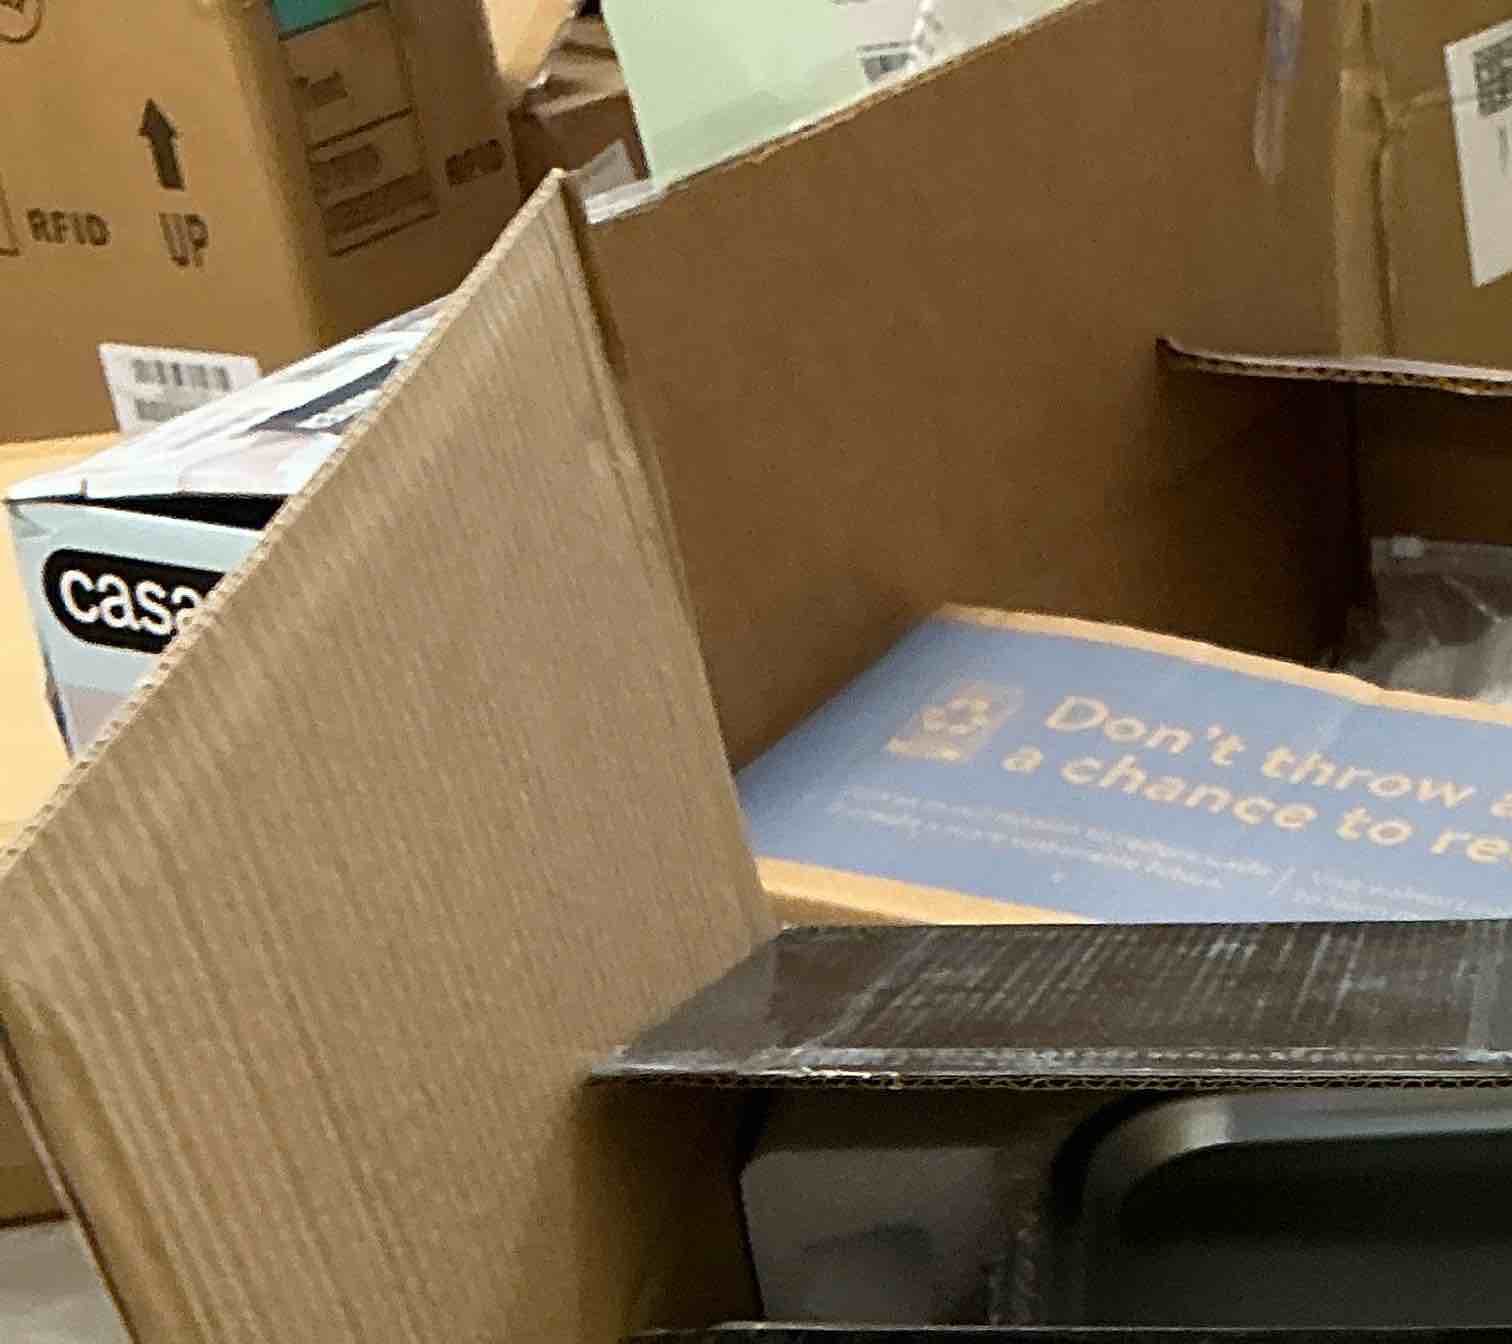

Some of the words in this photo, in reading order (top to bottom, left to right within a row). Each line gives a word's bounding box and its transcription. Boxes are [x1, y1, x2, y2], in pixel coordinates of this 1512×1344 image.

[27, 207, 111, 246] RFID
[158, 211, 208, 267] UP
[1044, 695, 1247, 767] Don't
[1260, 745, 1476, 808] throw
[1001, 746, 1043, 773] a
[1060, 754, 1319, 832] chance
[1334, 806, 1413, 847] to
